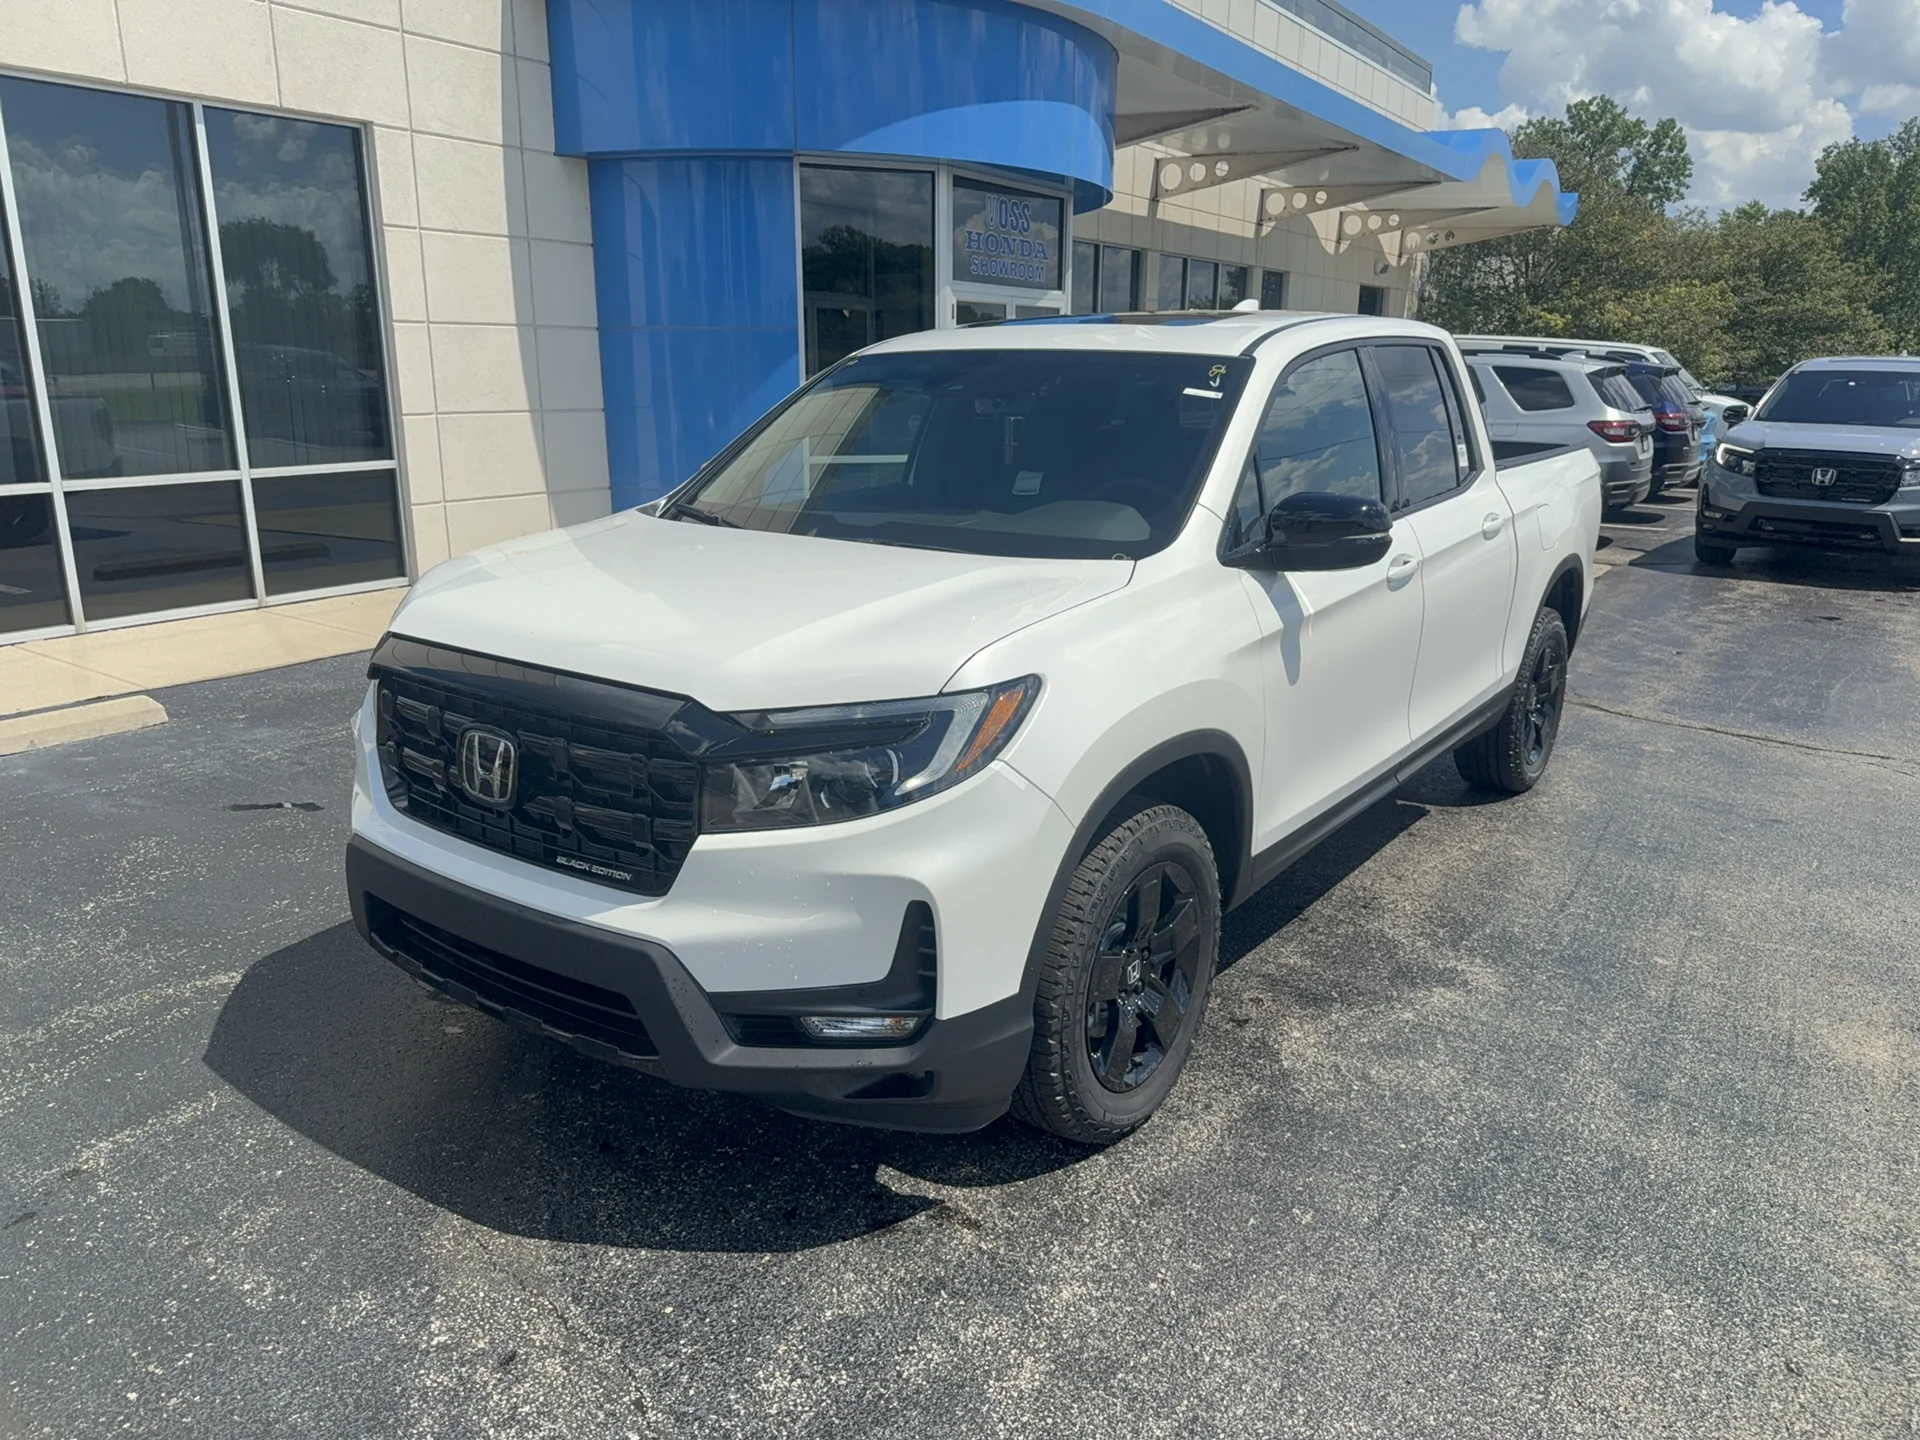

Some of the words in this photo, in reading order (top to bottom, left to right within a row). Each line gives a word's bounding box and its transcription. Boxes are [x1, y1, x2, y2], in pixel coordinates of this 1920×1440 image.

[986, 194, 1031, 233] VOSS
[965, 230, 1049, 262] HONDA
[970, 256, 1045, 282] SHOWROOM
[556, 855, 590, 871] BLACK
[591, 865, 632, 881] EDITION
